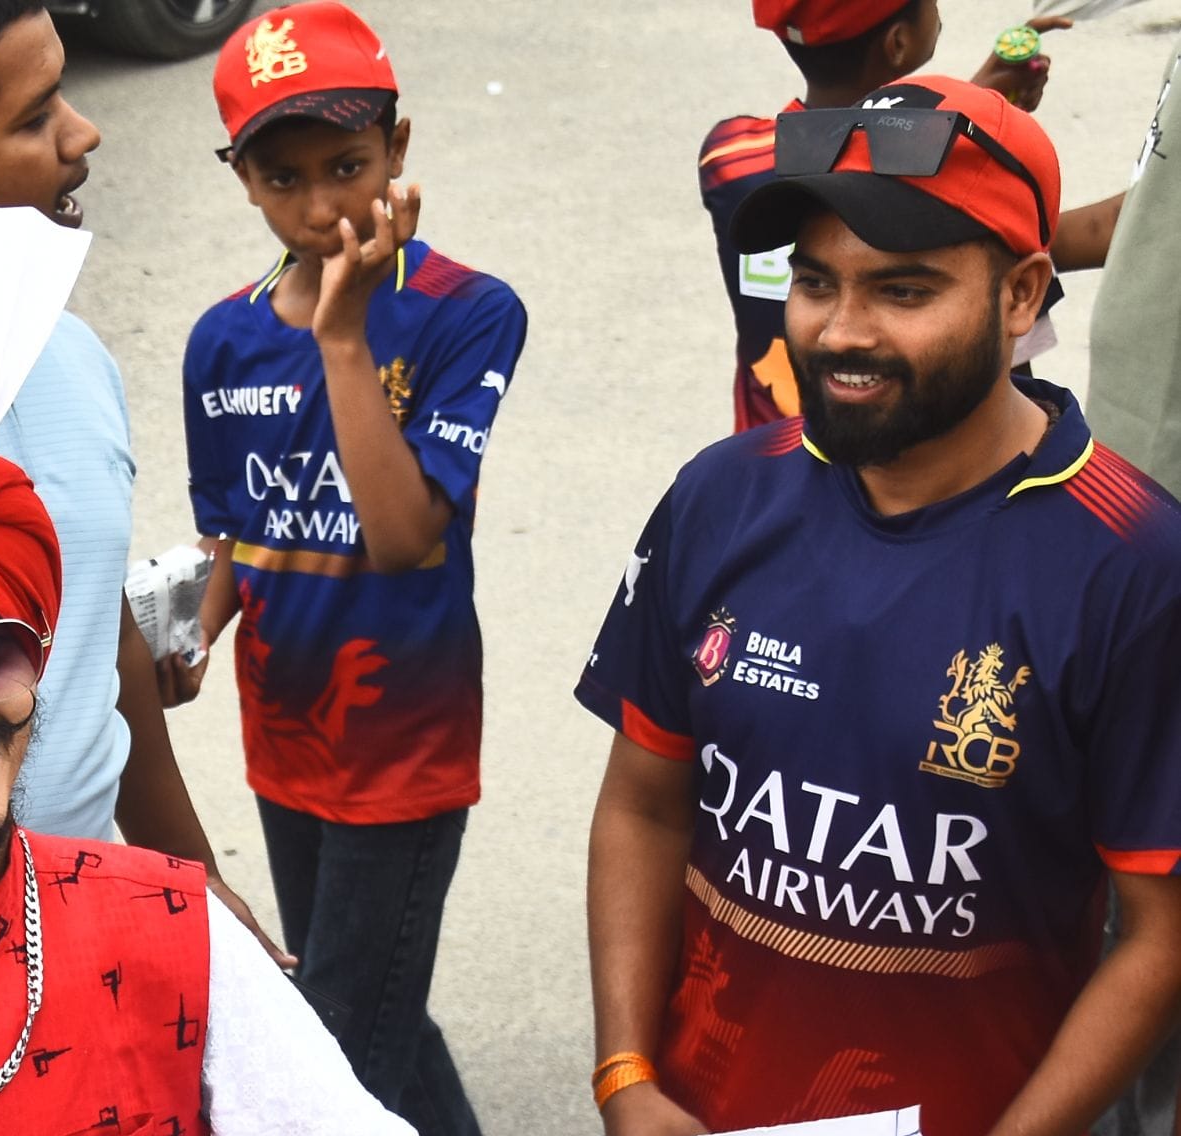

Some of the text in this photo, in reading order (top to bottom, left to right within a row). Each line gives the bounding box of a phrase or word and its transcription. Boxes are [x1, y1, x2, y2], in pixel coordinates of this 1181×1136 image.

[250, 51, 308, 89] RCB
[877, 115, 915, 132] KORS
[745, 631, 802, 665] BIRLA
[732, 661, 820, 700] ESTATES
[927, 720, 1021, 778] RCB
[700, 743, 988, 885] QATAR
[726, 848, 977, 938] AIRWAYS
